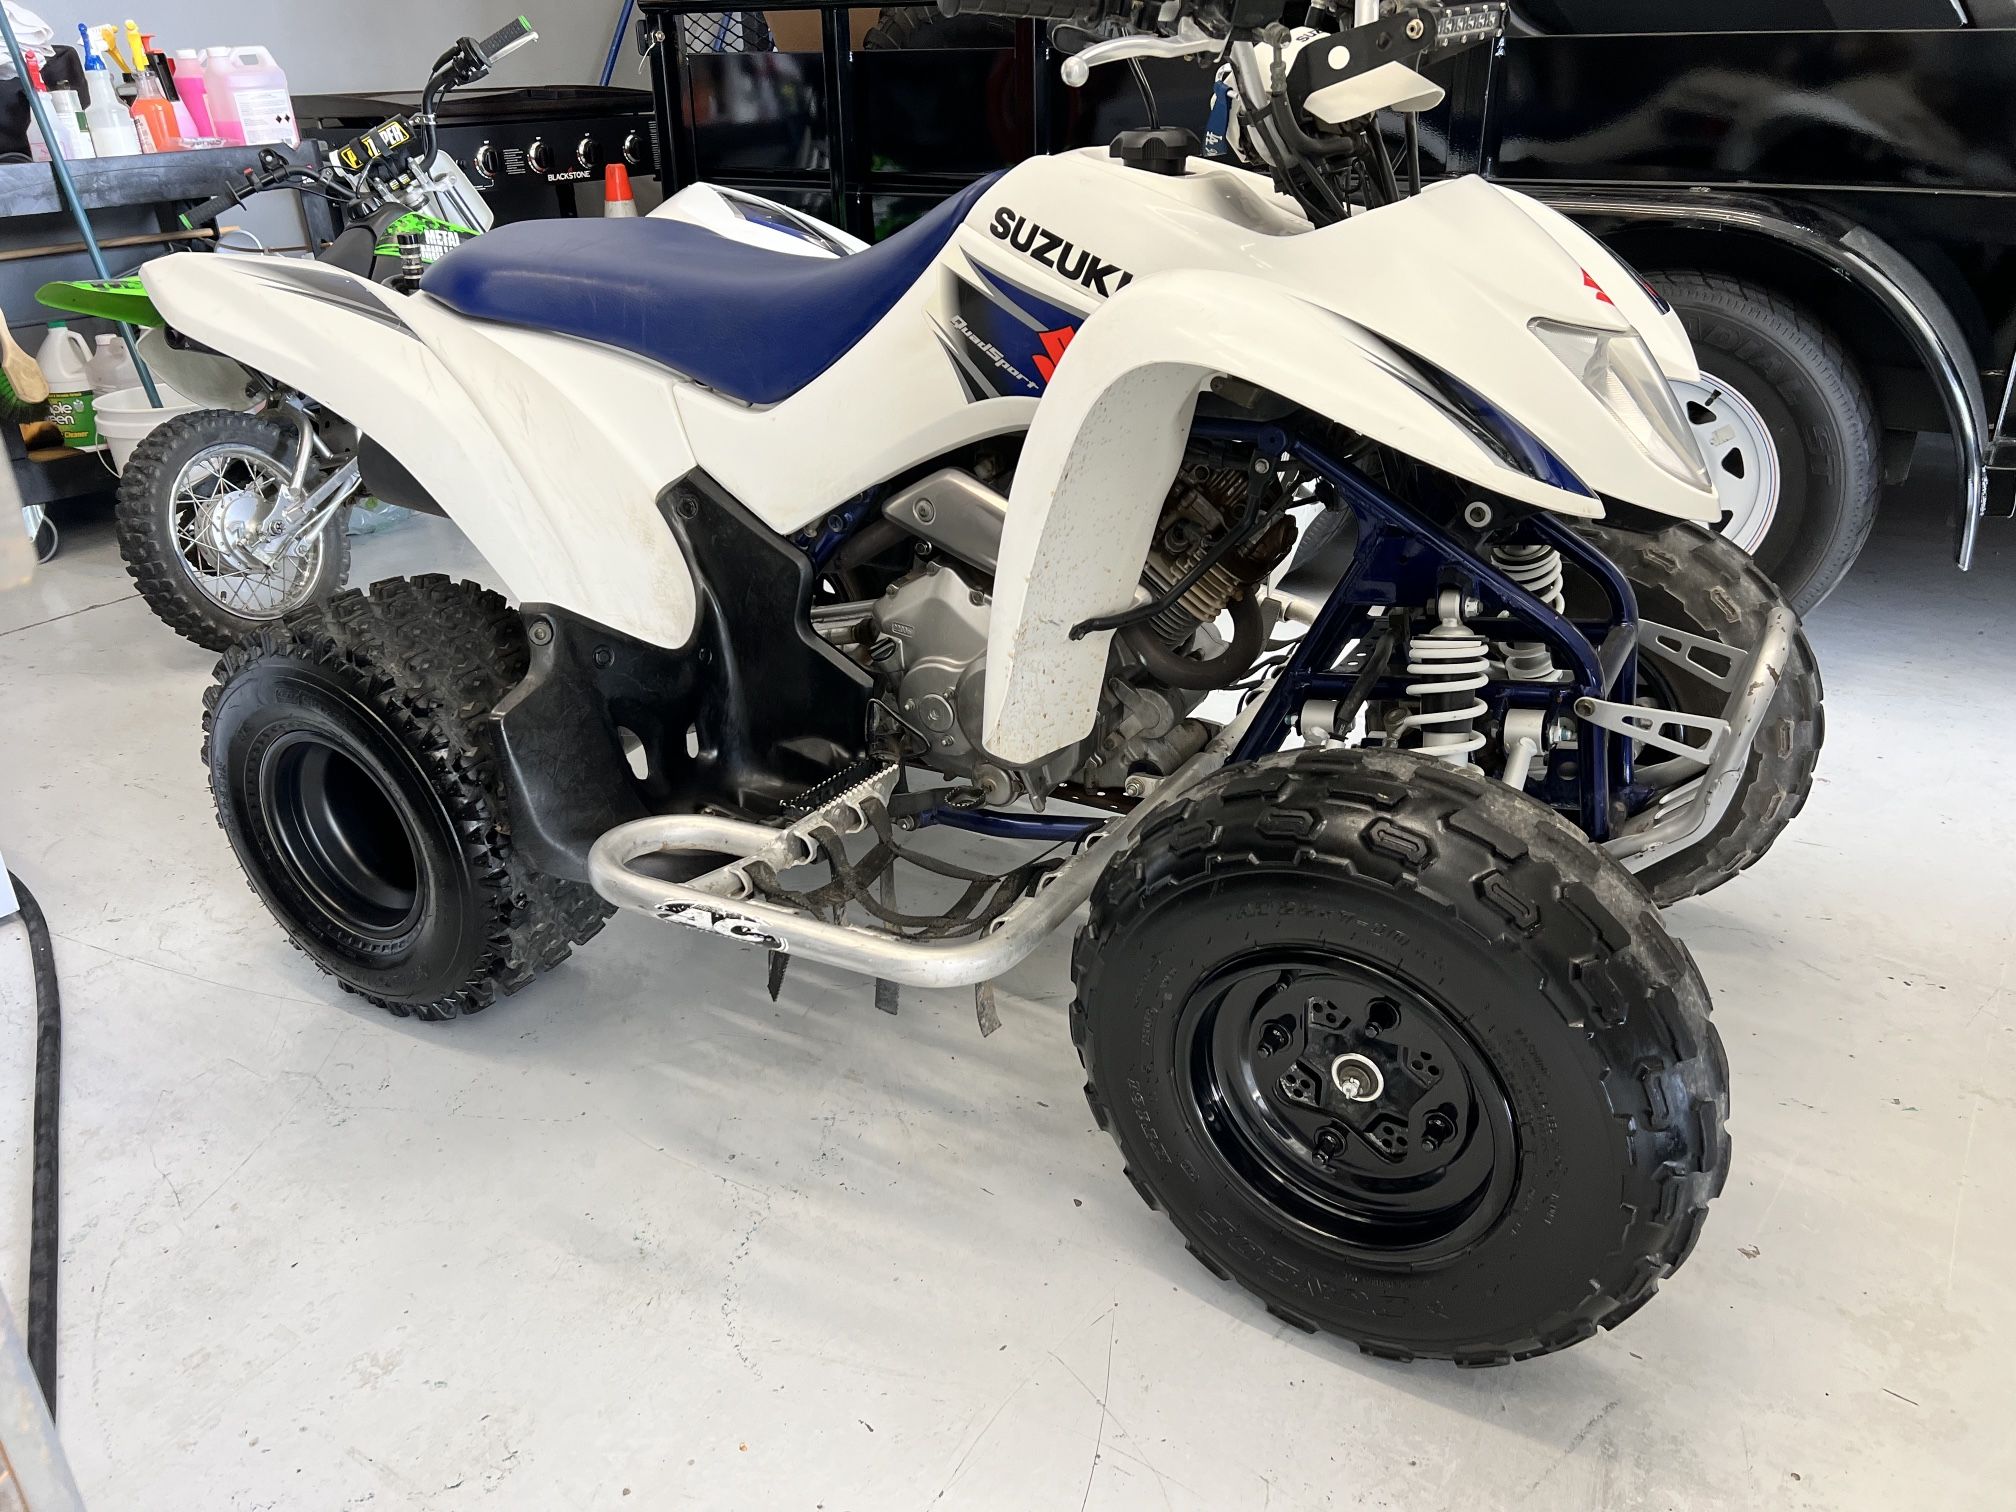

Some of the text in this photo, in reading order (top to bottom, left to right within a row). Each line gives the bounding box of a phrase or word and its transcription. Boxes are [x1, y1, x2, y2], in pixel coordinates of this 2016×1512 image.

[547, 170, 591, 182] BLACKSTONE
[950, 314, 1039, 390] QuadSport
[50, 401, 73, 416] ple
